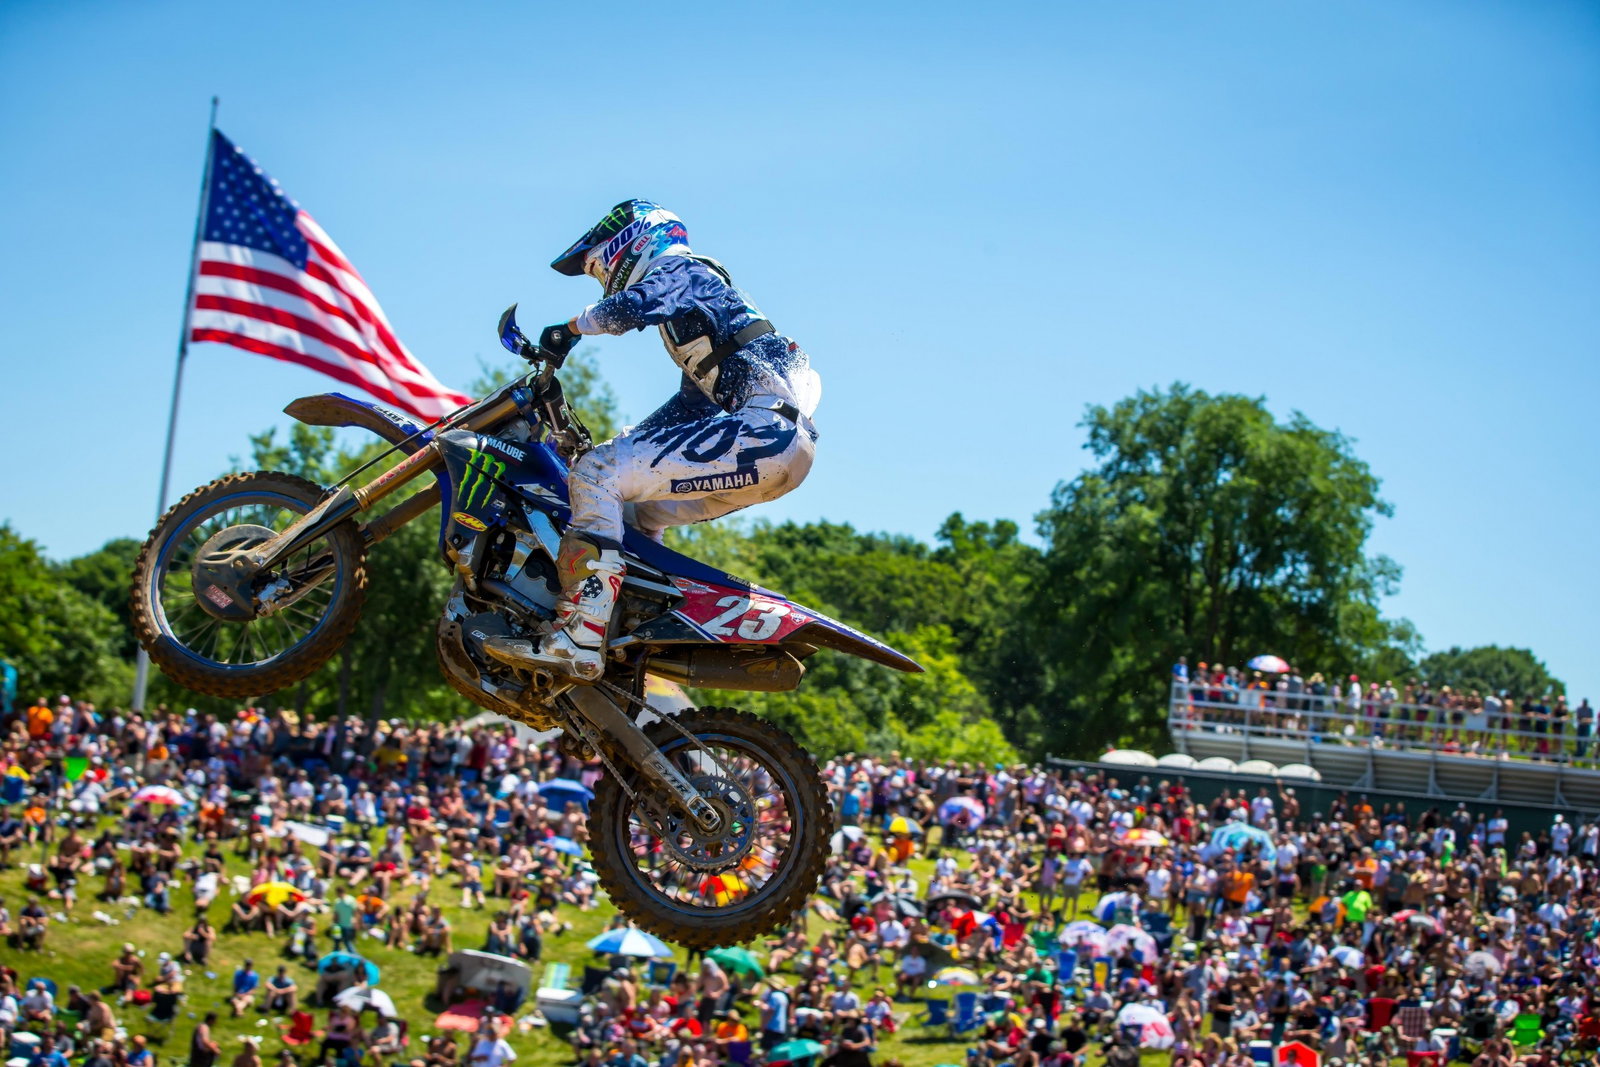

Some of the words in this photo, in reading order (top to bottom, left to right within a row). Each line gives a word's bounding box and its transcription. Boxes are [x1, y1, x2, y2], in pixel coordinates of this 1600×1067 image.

[602, 216, 651, 264] 100%
[634, 236, 650, 252] BELL
[693, 472, 754, 491] YAMAHA
[701, 595, 791, 641] 23
